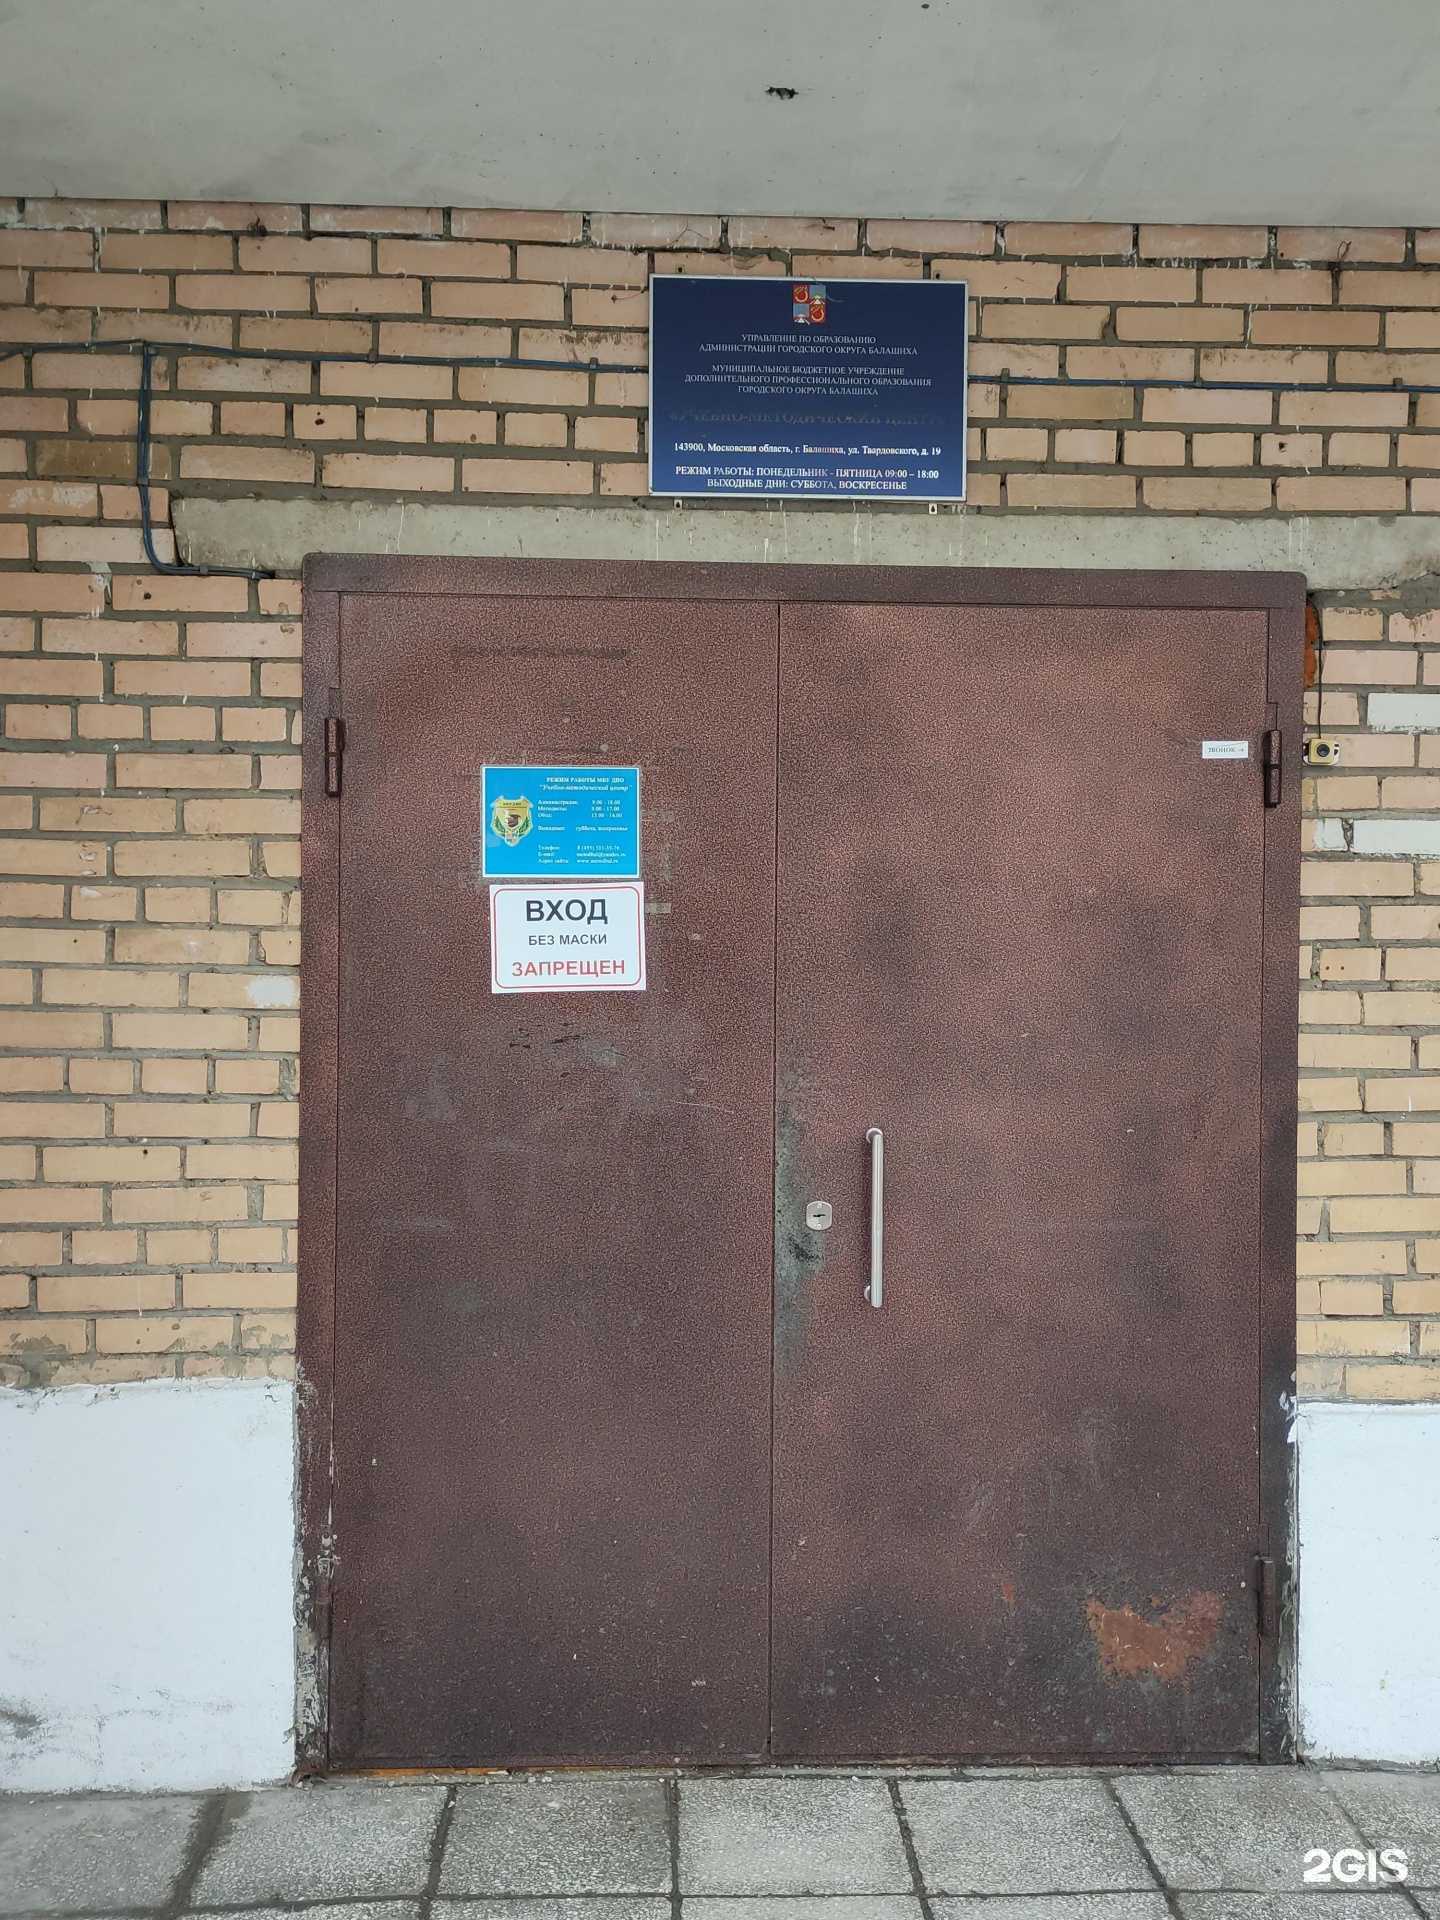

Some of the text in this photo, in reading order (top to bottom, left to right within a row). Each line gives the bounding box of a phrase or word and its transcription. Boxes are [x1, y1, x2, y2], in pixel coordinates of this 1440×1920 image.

[741, 334, 876, 344] УПРАВЛЕНИЕ ПО ОБРАЗОВАНИЮ
[699, 343, 918, 355] АДМИНИСТРАЦИИ ГОРОДСКОГО ОКРУГА БАЛАШИХА
[712, 364, 905, 376] МУНИЦИПАЛЬНОЕ БЮДЖЕТНОЕ УЧРЕЖДЕНИЕ
[684, 374, 932, 386] ДОПОЛНИТЕЛЬНОГО ПРОФЕССИОНАЛЬНОГО ОБРАЗОВАНИЯ
[738, 385, 879, 395] ГОРОДСКОГО ОКРУГА БАЛАШИХА
[674, 442, 705, 452] 143900,
[707, 443, 757, 452] Московская
[758, 443, 792, 454] область,
[847, 447, 859, 456] ул.
[862, 445, 920, 456] Твардовского,
[931, 447, 941, 456] 19
[675, 466, 711, 476] РЕЖИМ
[713, 467, 755, 476] РАБОТЫ:
[756, 467, 828, 478] ПОНЕДЕЛЬНИК
[836, 468, 883, 479] ПЯТНИЦА
[884, 469, 908, 478] 09:00
[917, 470, 940, 479] 18:00
[707, 479, 908, 490] ВЫХОДНЫЕ ДНИ: СУББОТА, ВОСКРЕСЕНЬЕ
[526, 898, 608, 925] ВХОД
[528, 934, 607, 946] БЕЗ МАСКИ
[512, 959, 625, 977] ЗАПРЕЩЕН
